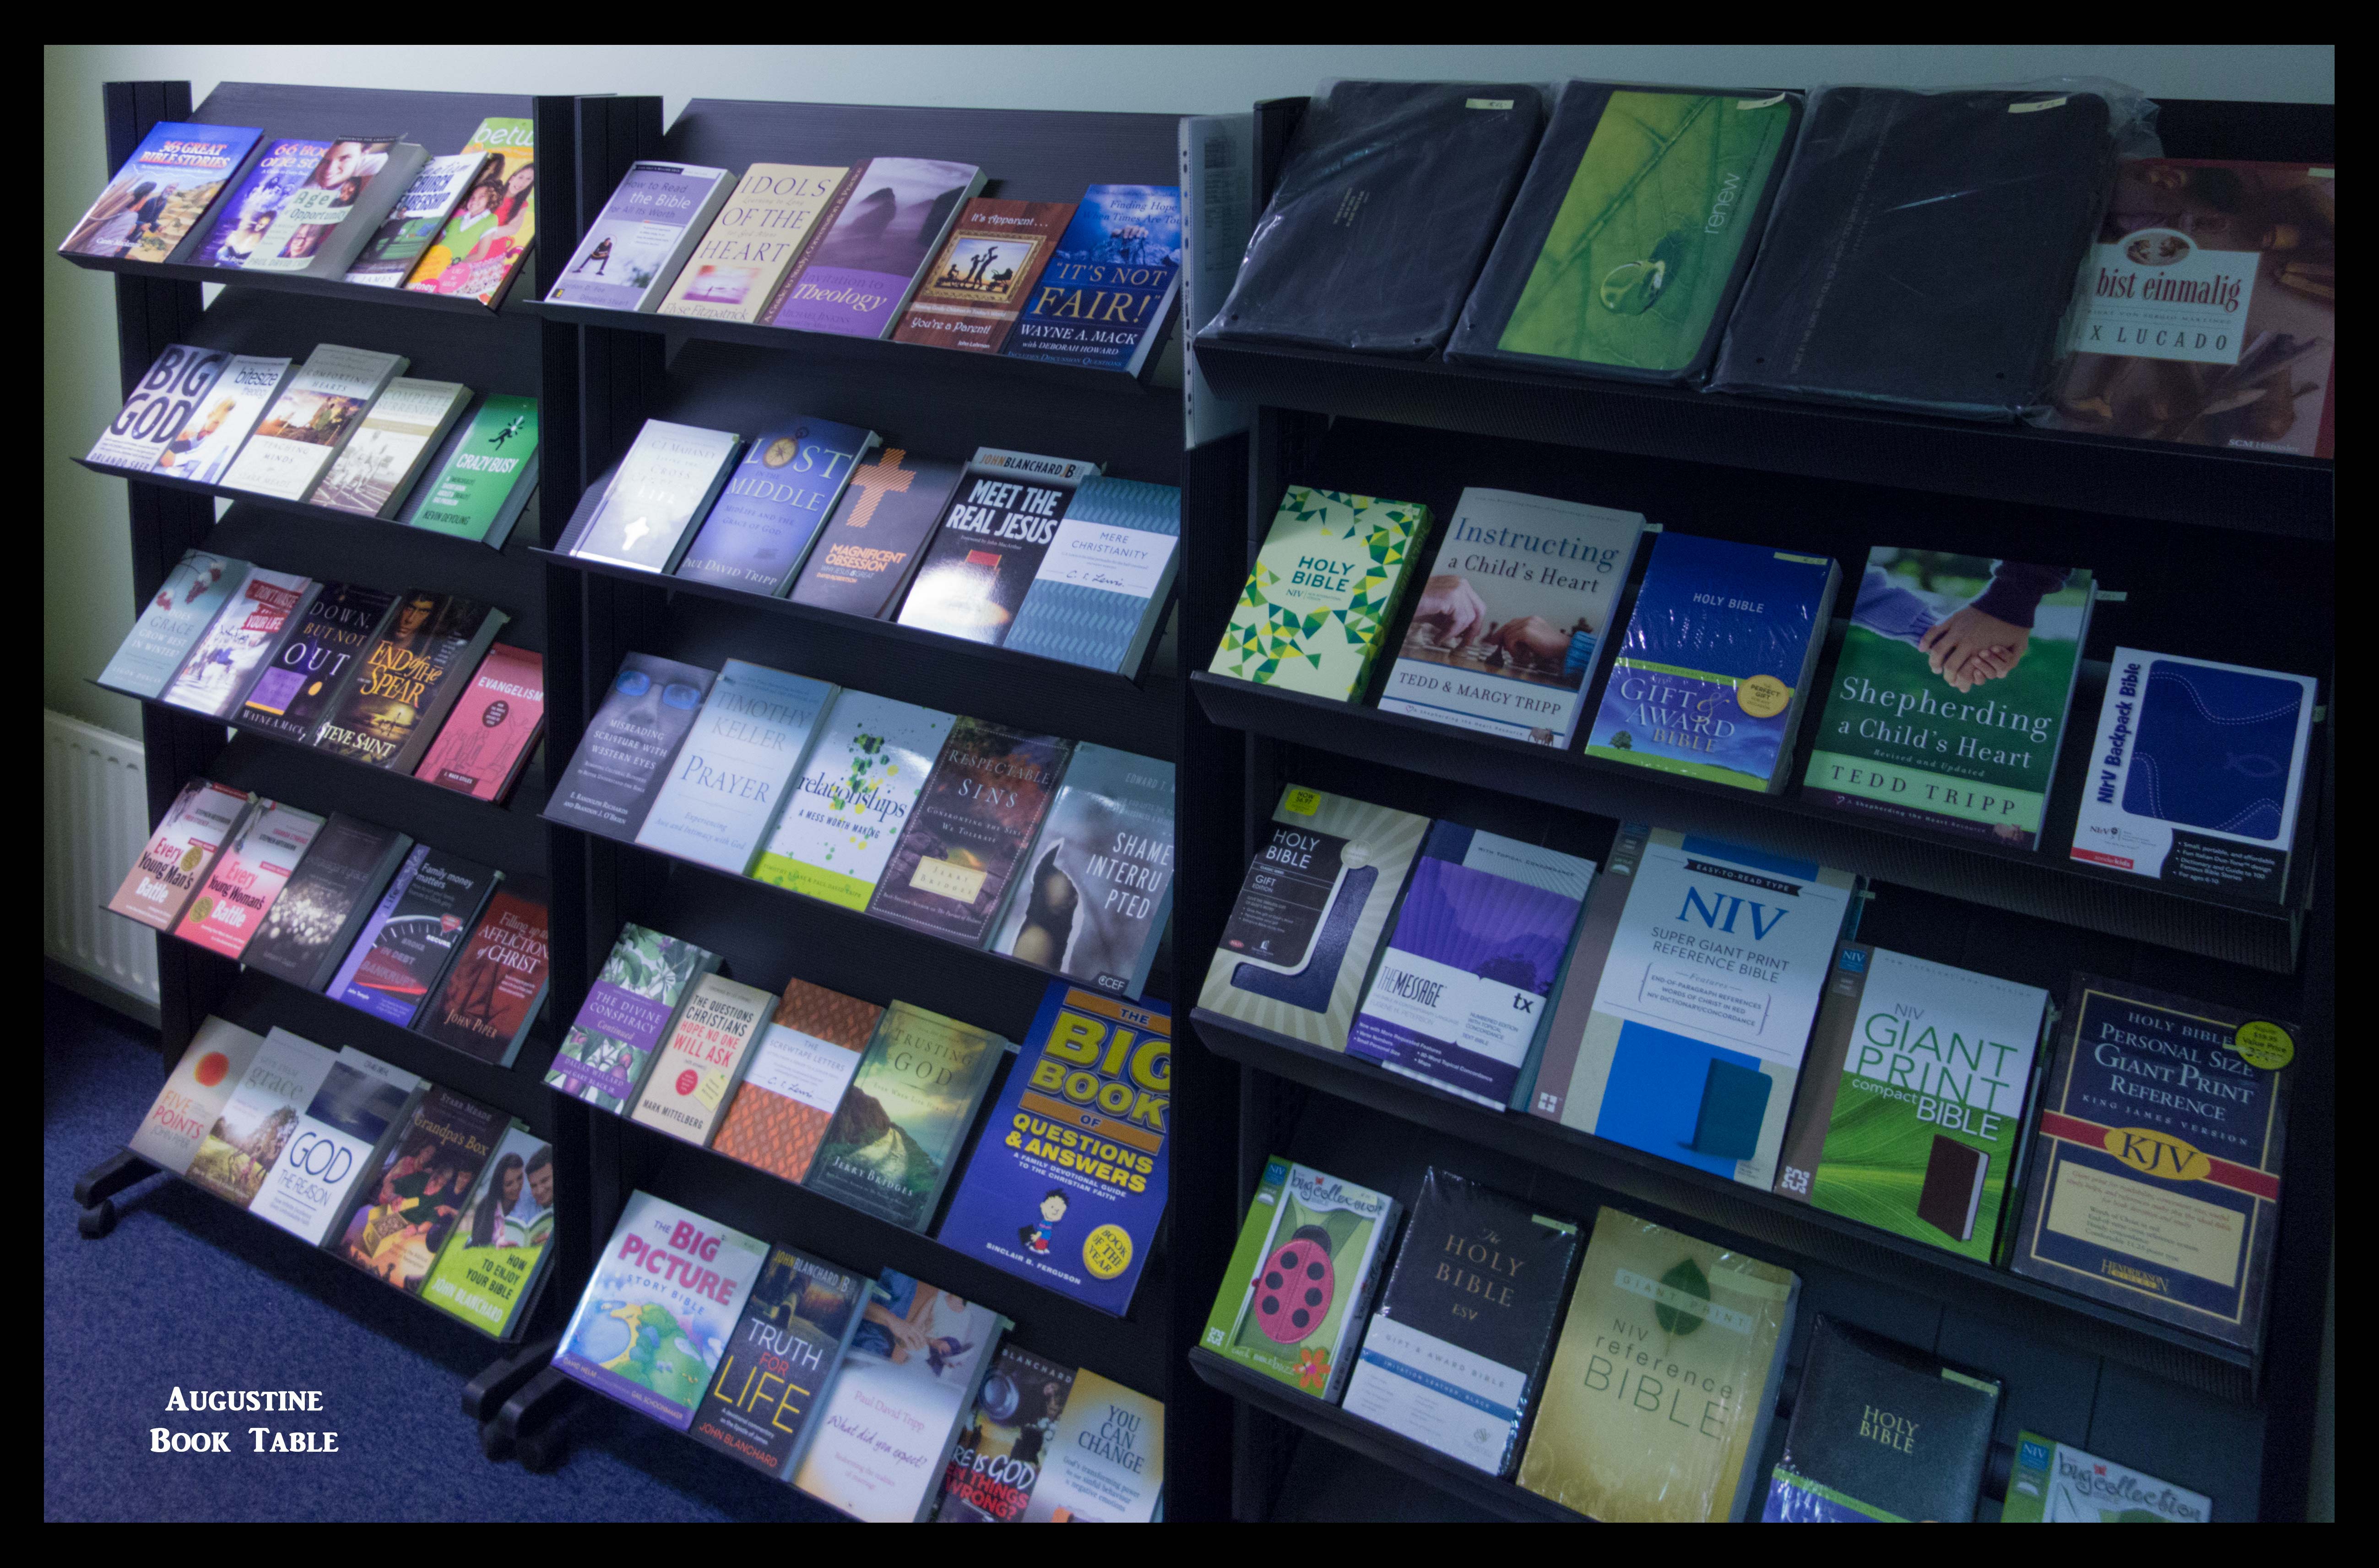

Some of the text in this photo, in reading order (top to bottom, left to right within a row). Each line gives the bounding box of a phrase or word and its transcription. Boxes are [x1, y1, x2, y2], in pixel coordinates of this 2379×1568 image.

[139, 150, 177, 165] BIBLE
[169, 154, 231, 169] STORIES
[159, 141, 227, 157] 365 GREAT
[630, 191, 691, 209] the Bible
[740, 175, 831, 197] IDOLS
[722, 208, 810, 229] OF THE
[1110, 200, 1176, 214] Finding Hope
[1705, 173, 1740, 234] renew
[698, 241, 790, 263] HEART
[1111, 267, 1167, 287] NOT
[2096, 268, 2242, 313] bist einmalig
[792, 283, 887, 312] Theology
[1030, 286, 1161, 323] FAIR!"
[1021, 324, 1138, 346] WAYNE A. MACK
[1023, 341, 1119, 356] with DEBORAH HOWARD
[2117, 327, 2228, 350] LUCADO
[144, 348, 222, 396] BIG
[235, 368, 278, 385] bitesize
[110, 393, 192, 443] GOD
[456, 454, 519, 473] CRAZY BUSY
[726, 477, 825, 512] MIDDLE
[968, 479, 1062, 515] MEET THE
[946, 504, 1057, 544] REAL JESUS
[1100, 531, 1129, 543] MERE
[830, 543, 906, 564] MAGNIFICENT
[1072, 540, 1148, 559] CHRISTIANITY
[1453, 517, 1619, 573] Instructing
[825, 553, 888, 572] OBSESSION
[1298, 556, 1355, 575] HOLY
[1448, 554, 1599, 593] a Child's Heart
[1291, 571, 1349, 592] BIBLE
[1693, 593, 1764, 613] HOLY BIBLE
[284, 642, 350, 677] OUT
[360, 665, 425, 708] SPEAR
[478, 676, 544, 702] EVANGELISM
[1399, 672, 1561, 715] TEDD & MARGY TRIPP
[1626, 703, 1735, 738] AWARD
[1839, 676, 2053, 743] Shepherding
[2105, 700, 2133, 767] Backpack
[2119, 663, 2141, 698] Bible
[321, 722, 396, 757] STEVE SAINT
[1653, 728, 1715, 753] BIBLE
[1838, 718, 2032, 769] a Child's Heart
[681, 755, 770, 803] PRAYER
[949, 749, 1049, 785] RESPECTABLE
[797, 772, 907, 822] relationships
[958, 778, 1019, 808] SINS
[1832, 765, 2015, 815] TEDD TRIPP
[806, 810, 824, 823] MESS
[827, 816, 850, 830] WORTH
[851, 823, 880, 839] MAKING
[1273, 829, 1320, 852] HOLY
[1113, 832, 1173, 865] SHAME
[1266, 845, 1312, 869] BIBLE
[226, 861, 259, 890] Every
[1086, 854, 1162, 892] INTERRU
[1255, 874, 1276, 886] GIFT
[1696, 863, 1790, 892] EASY-TO-READ TYPE
[208, 875, 266, 911] Young Woman's
[1105, 889, 1149, 919] PTED
[211, 900, 247, 928] Battle
[1675, 886, 1789, 940] NIV
[1652, 927, 1789, 971] SUPER GIANT PRINT
[1653, 941, 1780, 984] REFERENCE BIBLE
[1842, 949, 1865, 962] NIV
[693, 994, 753, 1023] THE QUESTIONS
[1512, 992, 1534, 1014] tx
[1651, 976, 1761, 1009] END-OF-PARAGRAPH REFERENCES
[686, 1007, 747, 1036] CHRISTIANS
[1120, 1008, 1150, 1025] THE
[1895, 1003, 1924, 1020] NIV
[680, 1020, 740, 1049] HOPE NO ONE
[2128, 1012, 2236, 1045] HOLY BIBLE
[673, 1033, 734, 1068] WILL ASK
[893, 1028, 971, 1066] TRUSTING
[1044, 1010, 1171, 1093] BIG
[1864, 1013, 2018, 1078] GIANT
[894, 1052, 953, 1087] GOD
[1856, 1045, 2010, 1112] PRINT
[1028, 1057, 1170, 1132] BOOK
[1852, 1079, 1918, 1104] compact
[642, 1099, 704, 1129] MARK MITTELBERG
[1080, 1114, 1101, 1128] OF
[1917, 1096, 2001, 1141] BIBLE
[2082, 1094, 2248, 1146] KING JAMES VERSION
[290, 1131, 352, 1185] GOD
[1013, 1113, 1154, 1174] QUESTIONS
[2119, 1132, 2197, 1174] KJV
[1005, 1131, 1147, 1193] & ANSWERS
[277, 1168, 298, 1188] THE
[295, 1176, 332, 1207] REASON
[654, 1219, 721, 1262] THE BIG
[1445, 1235, 1525, 1277] HOLY
[482, 1258, 521, 1286] TO ENJOY
[506, 1253, 526, 1271] HOW
[618, 1232, 737, 1306] PICTURE
[986, 1242, 1081, 1285] SINCLAIR B. FERGUSON
[466, 1268, 513, 1300] YOUR BIBLE
[627, 1274, 705, 1315] STORY BIBLE
[1436, 1263, 1514, 1308] BIBLE
[1452, 1303, 1478, 1320] ESV
[748, 1318, 823, 1371] TRUTH
[1612, 1318, 1648, 1340] NIV
[759, 1353, 789, 1376] FOR
[1596, 1335, 1733, 1399] reference
[714, 1355, 810, 1433] LIFE
[1584, 1355, 1729, 1441] BIBLE
[1109, 1405, 1141, 1432] YOU
[1864, 1405, 1919, 1438] HOLY
[1100, 1422, 1136, 1449] CAN
[1860, 1420, 1914, 1454] BIBLE
[1078, 1431, 1144, 1474] CHANGE
